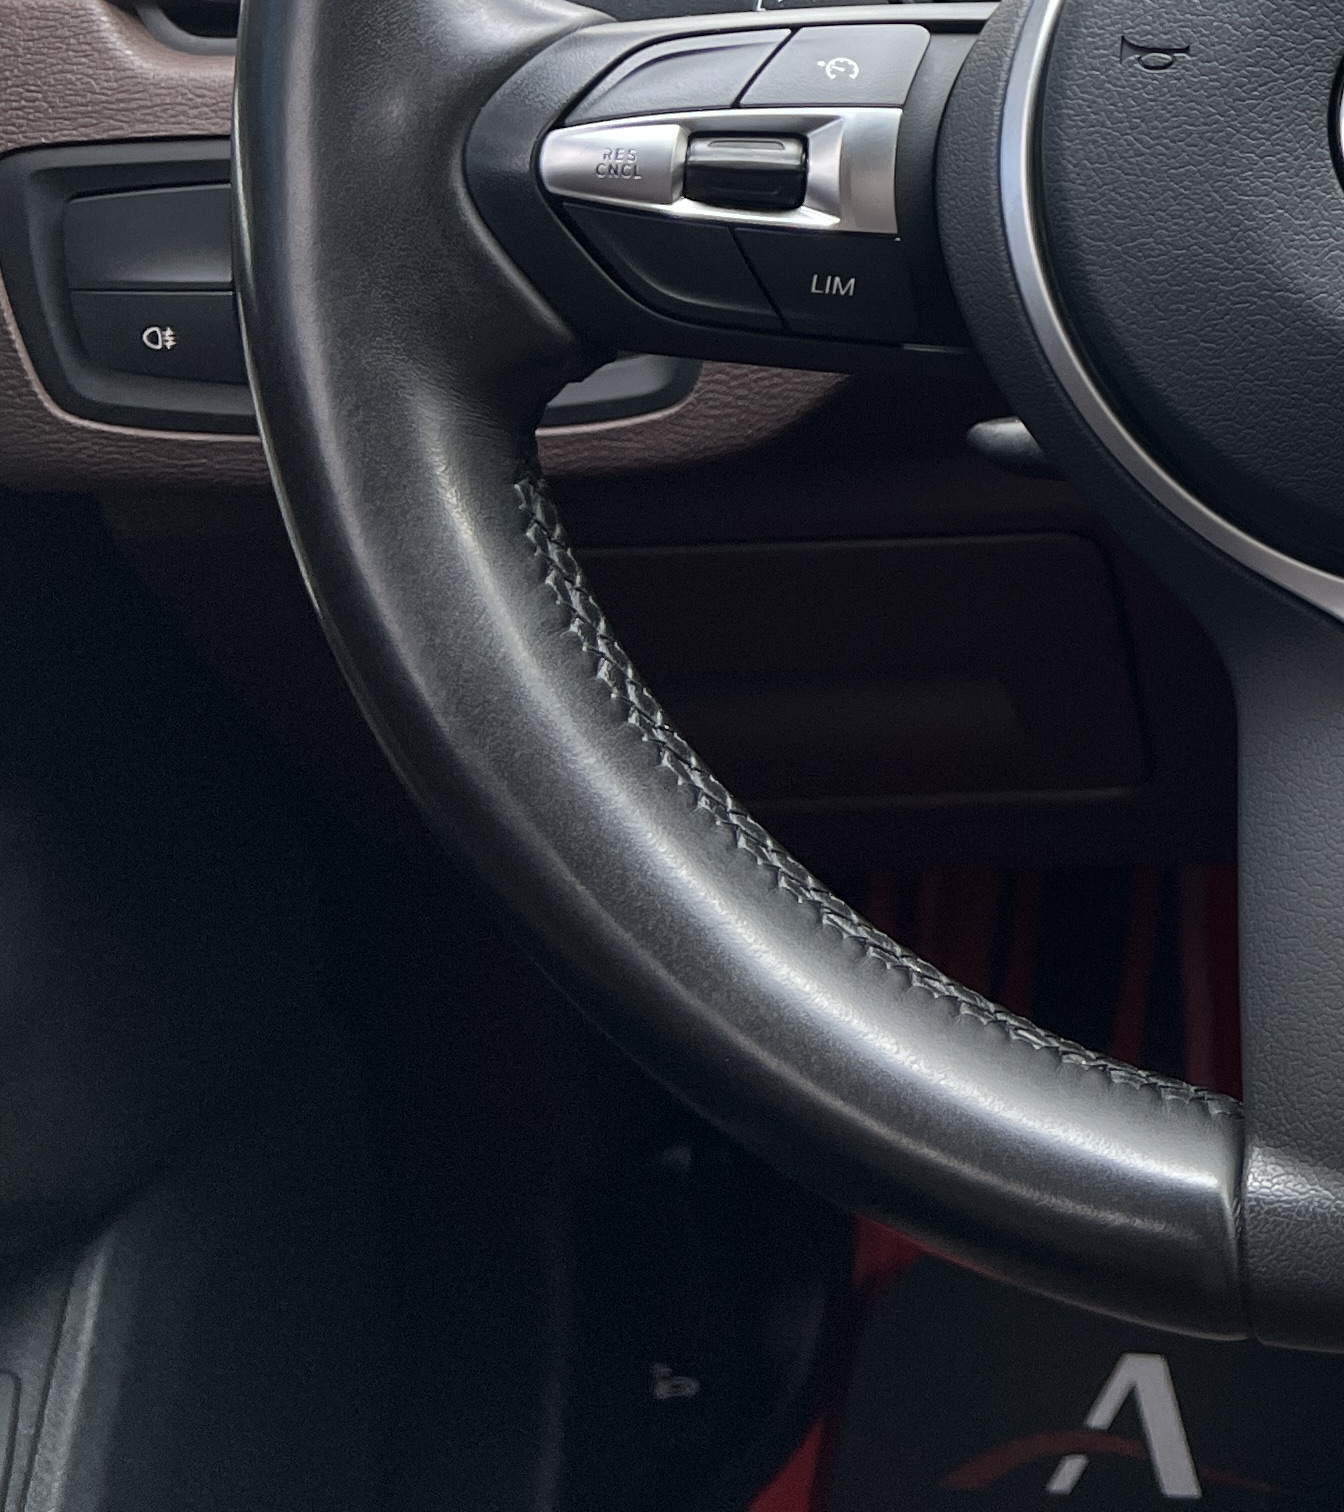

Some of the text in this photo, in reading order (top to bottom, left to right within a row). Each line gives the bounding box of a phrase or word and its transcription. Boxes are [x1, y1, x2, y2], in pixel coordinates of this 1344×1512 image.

[601, 147, 639, 163] RES
[595, 162, 643, 180] CNCL
[810, 273, 856, 297] LIM
